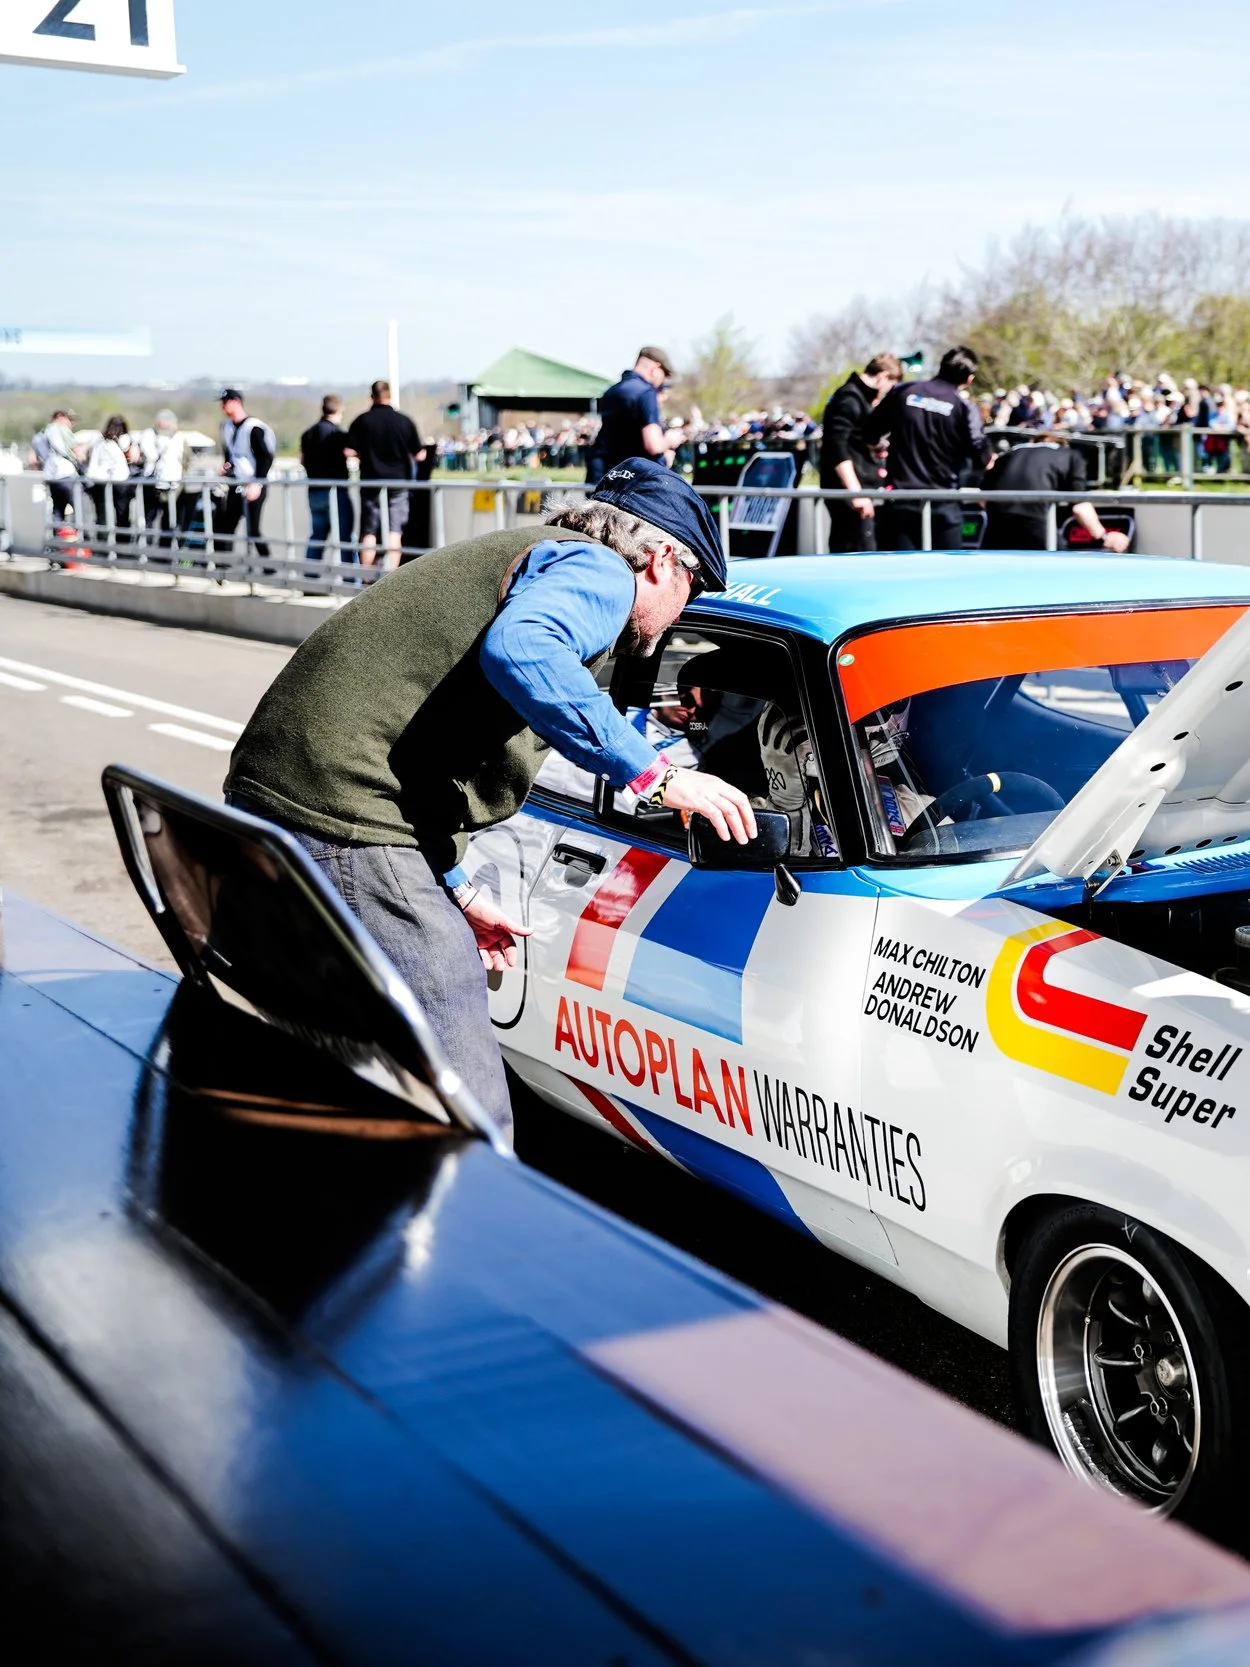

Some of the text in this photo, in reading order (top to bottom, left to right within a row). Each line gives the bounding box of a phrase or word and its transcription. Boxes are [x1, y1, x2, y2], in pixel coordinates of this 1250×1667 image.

[873, 936, 987, 989] MAX CHILTON
[872, 971, 958, 1015] ANDREW
[864, 994, 980, 1053] DONALDSON
[1145, 1024, 1243, 1081] Shell
[555, 995, 926, 1212] AUTOPLAN WARRANTIES
[1128, 1066, 1236, 1129] Super
